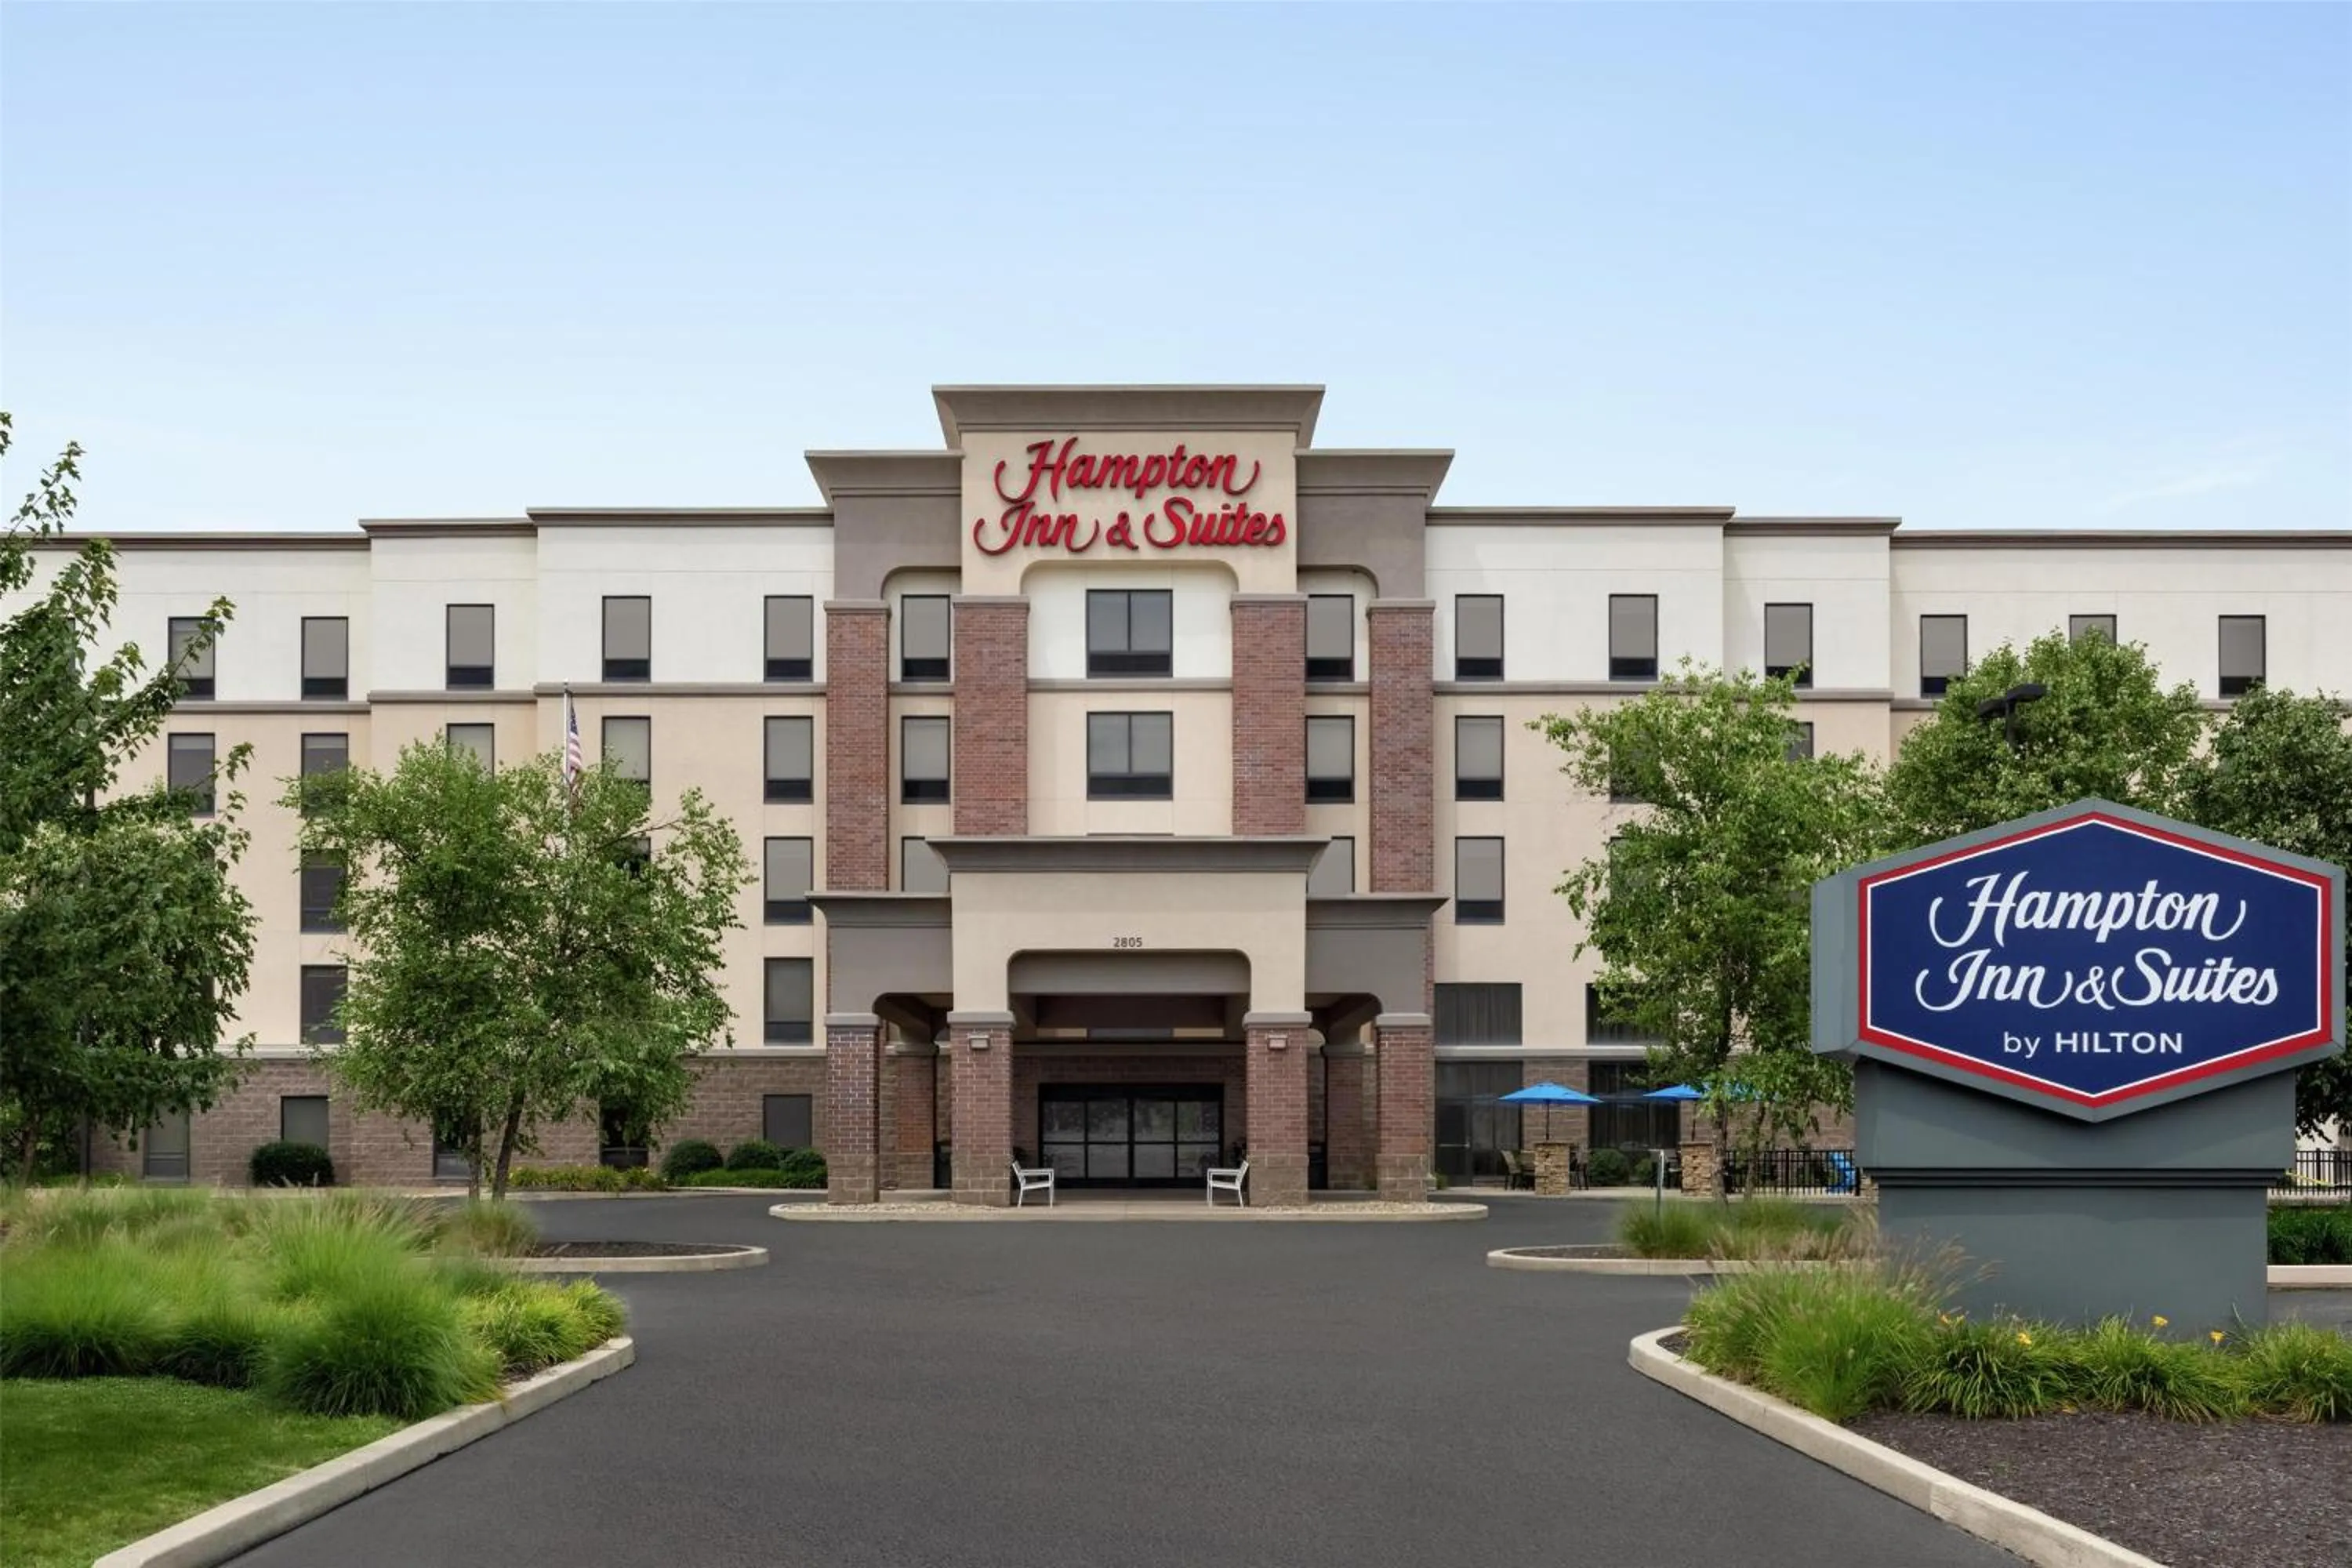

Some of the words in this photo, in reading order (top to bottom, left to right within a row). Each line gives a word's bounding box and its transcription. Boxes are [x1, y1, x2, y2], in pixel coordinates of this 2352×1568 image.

[993, 437, 1261, 504] Hampton
[973, 500, 1099, 556] Inn
[1105, 511, 1139, 550] &
[1143, 495, 1287, 549] Suites
[1929, 871, 2246, 948] Hampton
[1113, 937, 1143, 948] 2805
[1915, 948, 2074, 1011] Inn
[2074, 965, 2115, 1011] &
[2111, 947, 2279, 1007] Suites
[2004, 1031, 2041, 1059] by
[2055, 1032, 2183, 1054] HILTON
